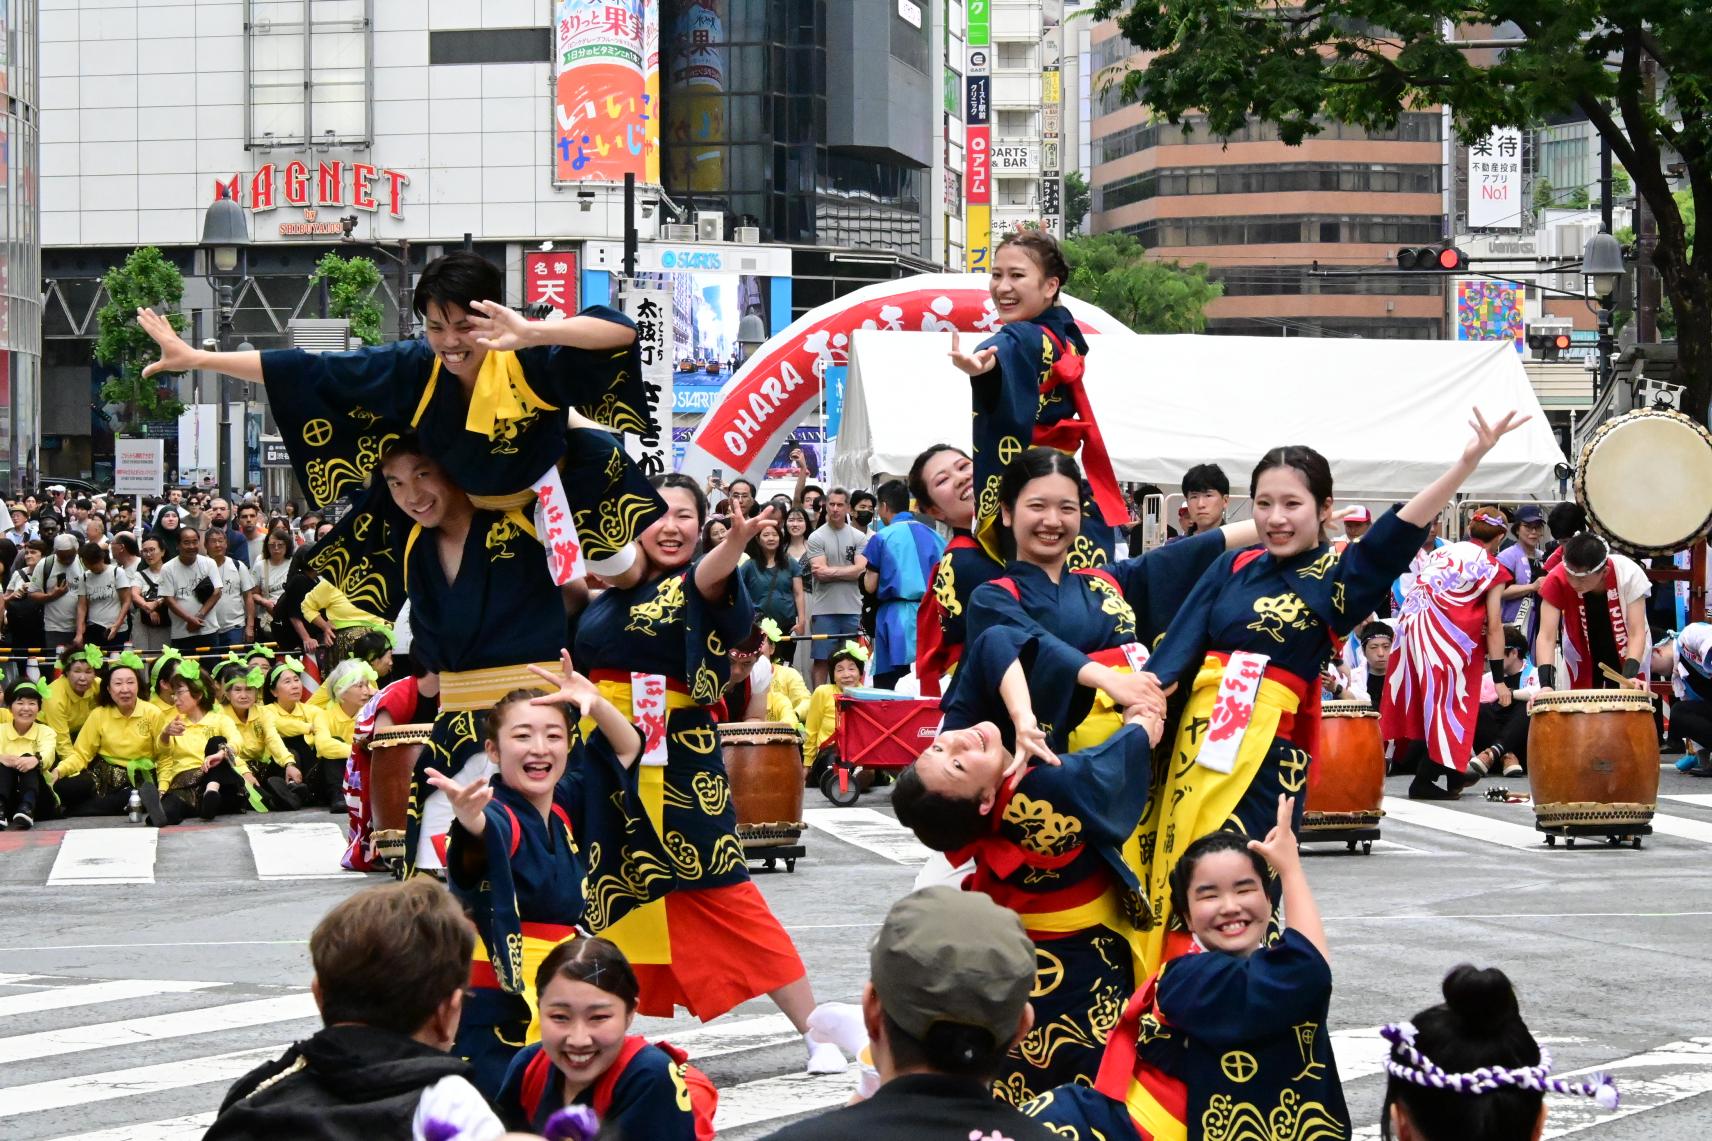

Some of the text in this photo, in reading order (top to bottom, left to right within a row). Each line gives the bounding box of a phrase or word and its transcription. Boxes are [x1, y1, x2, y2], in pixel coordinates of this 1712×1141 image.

[970, 84, 978, 115] クリニック
[978, 79, 987, 120] イースト駅前
[1003, 158, 1028, 168] BAR
[1472, 162, 1518, 173] 不動産投資
[972, 154, 985, 193] アコム
[1482, 174, 1508, 183] アプリ
[214, 160, 411, 221] MAGNET
[303, 208, 318, 223] by
[279, 223, 344, 236] SHIBUYA109
[534, 261, 568, 275] 名物
[723, 360, 804, 457] OHARA
